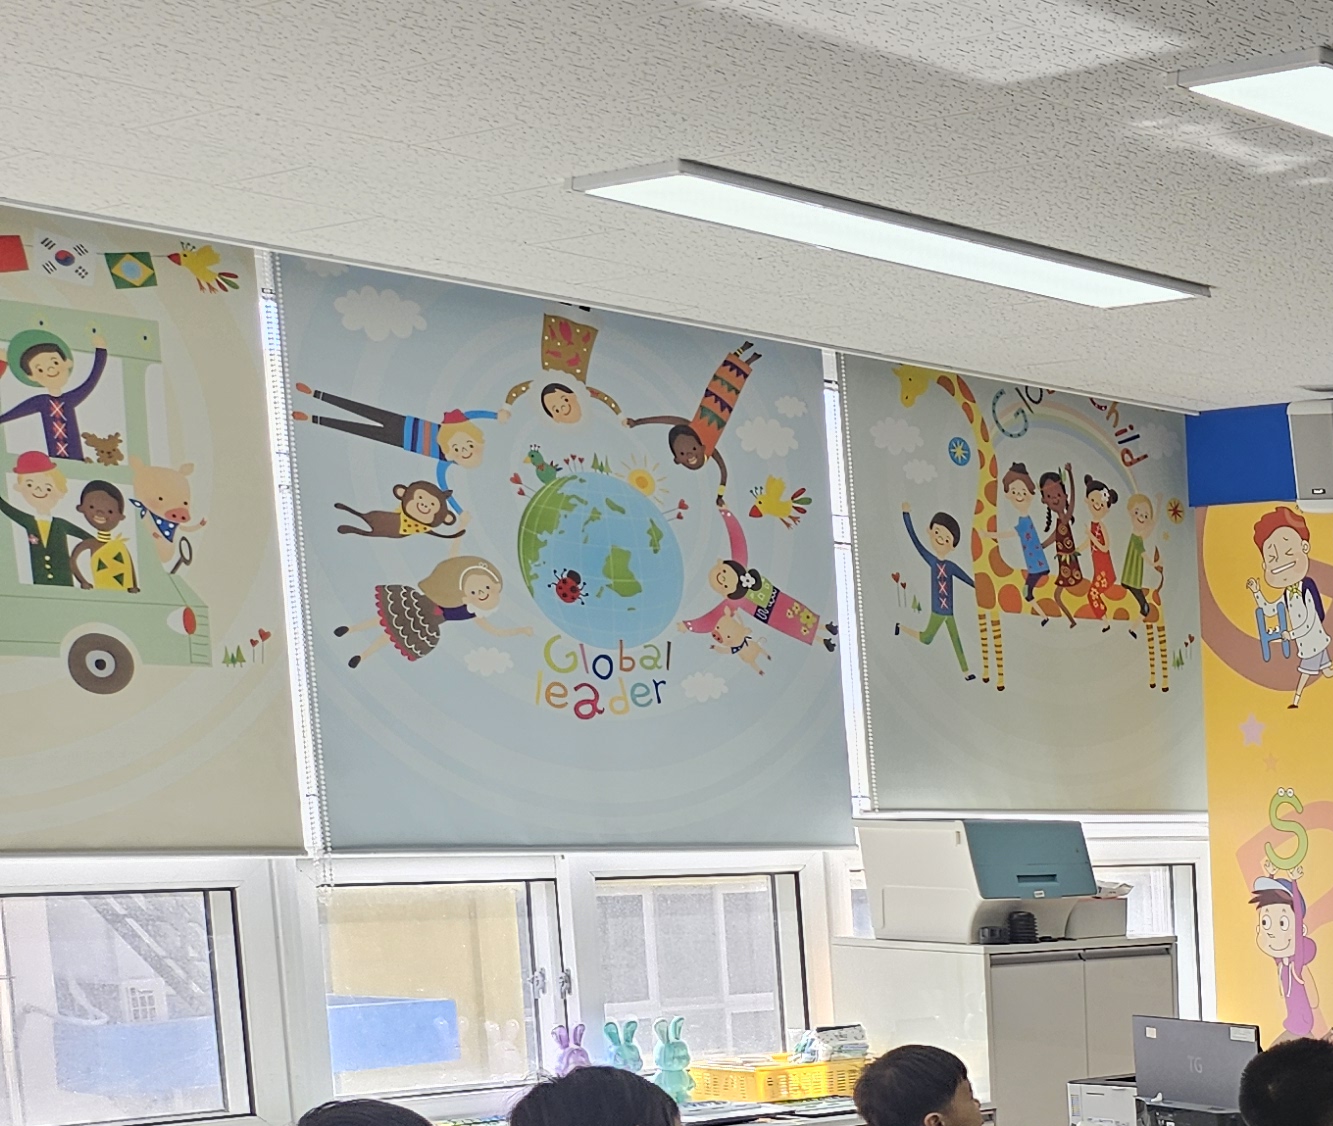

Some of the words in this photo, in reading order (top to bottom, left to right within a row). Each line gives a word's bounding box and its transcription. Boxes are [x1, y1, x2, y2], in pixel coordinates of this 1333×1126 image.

[543, 633, 672, 681] Global
[534, 669, 667, 721] leader
[1187, 1055, 1204, 1074] TG
